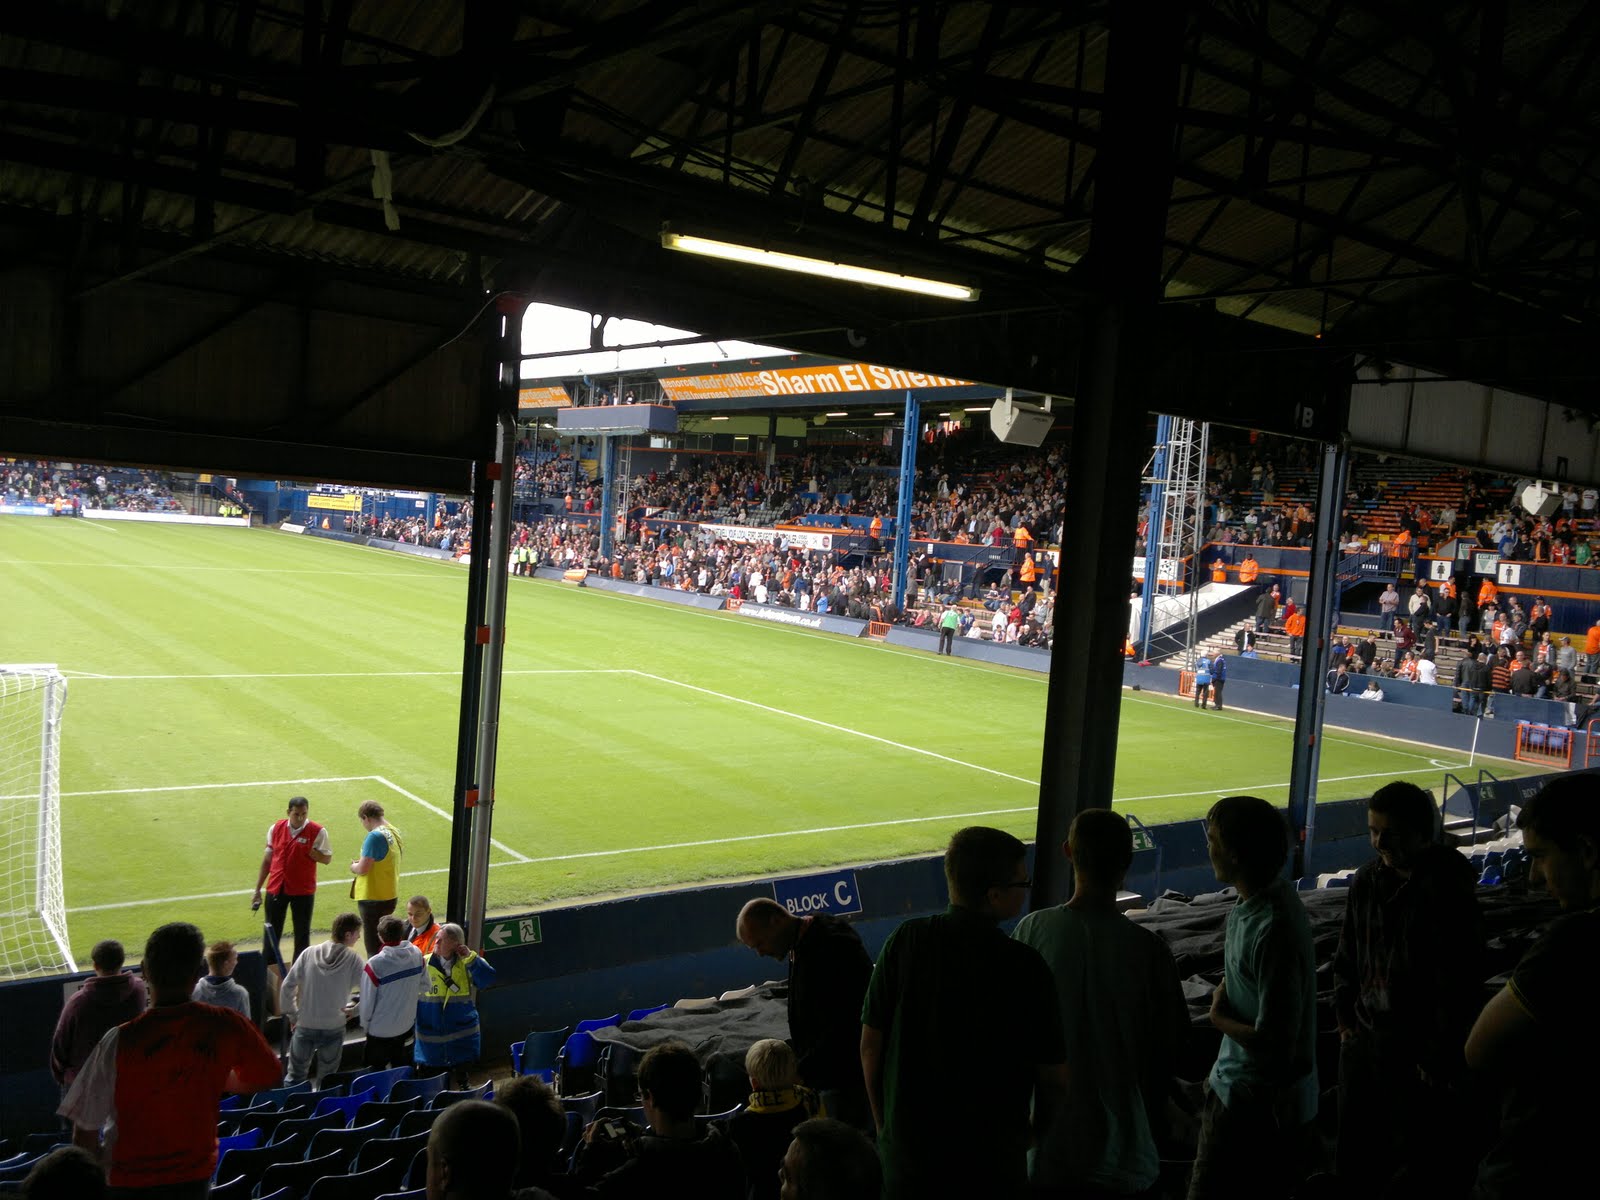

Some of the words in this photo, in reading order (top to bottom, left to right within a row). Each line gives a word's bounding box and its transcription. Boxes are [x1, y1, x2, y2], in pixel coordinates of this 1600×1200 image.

[691, 373, 734, 389] Madrid
[732, 372, 763, 388] Nice
[760, 369, 842, 396] Sharm
[837, 363, 869, 391] El
[665, 388, 692, 400] Pisa
[690, 390, 729, 400] Inverness
[1302, 406, 1314, 428] B
[785, 893, 830, 914] BLOCK
[834, 880, 852, 906] C
